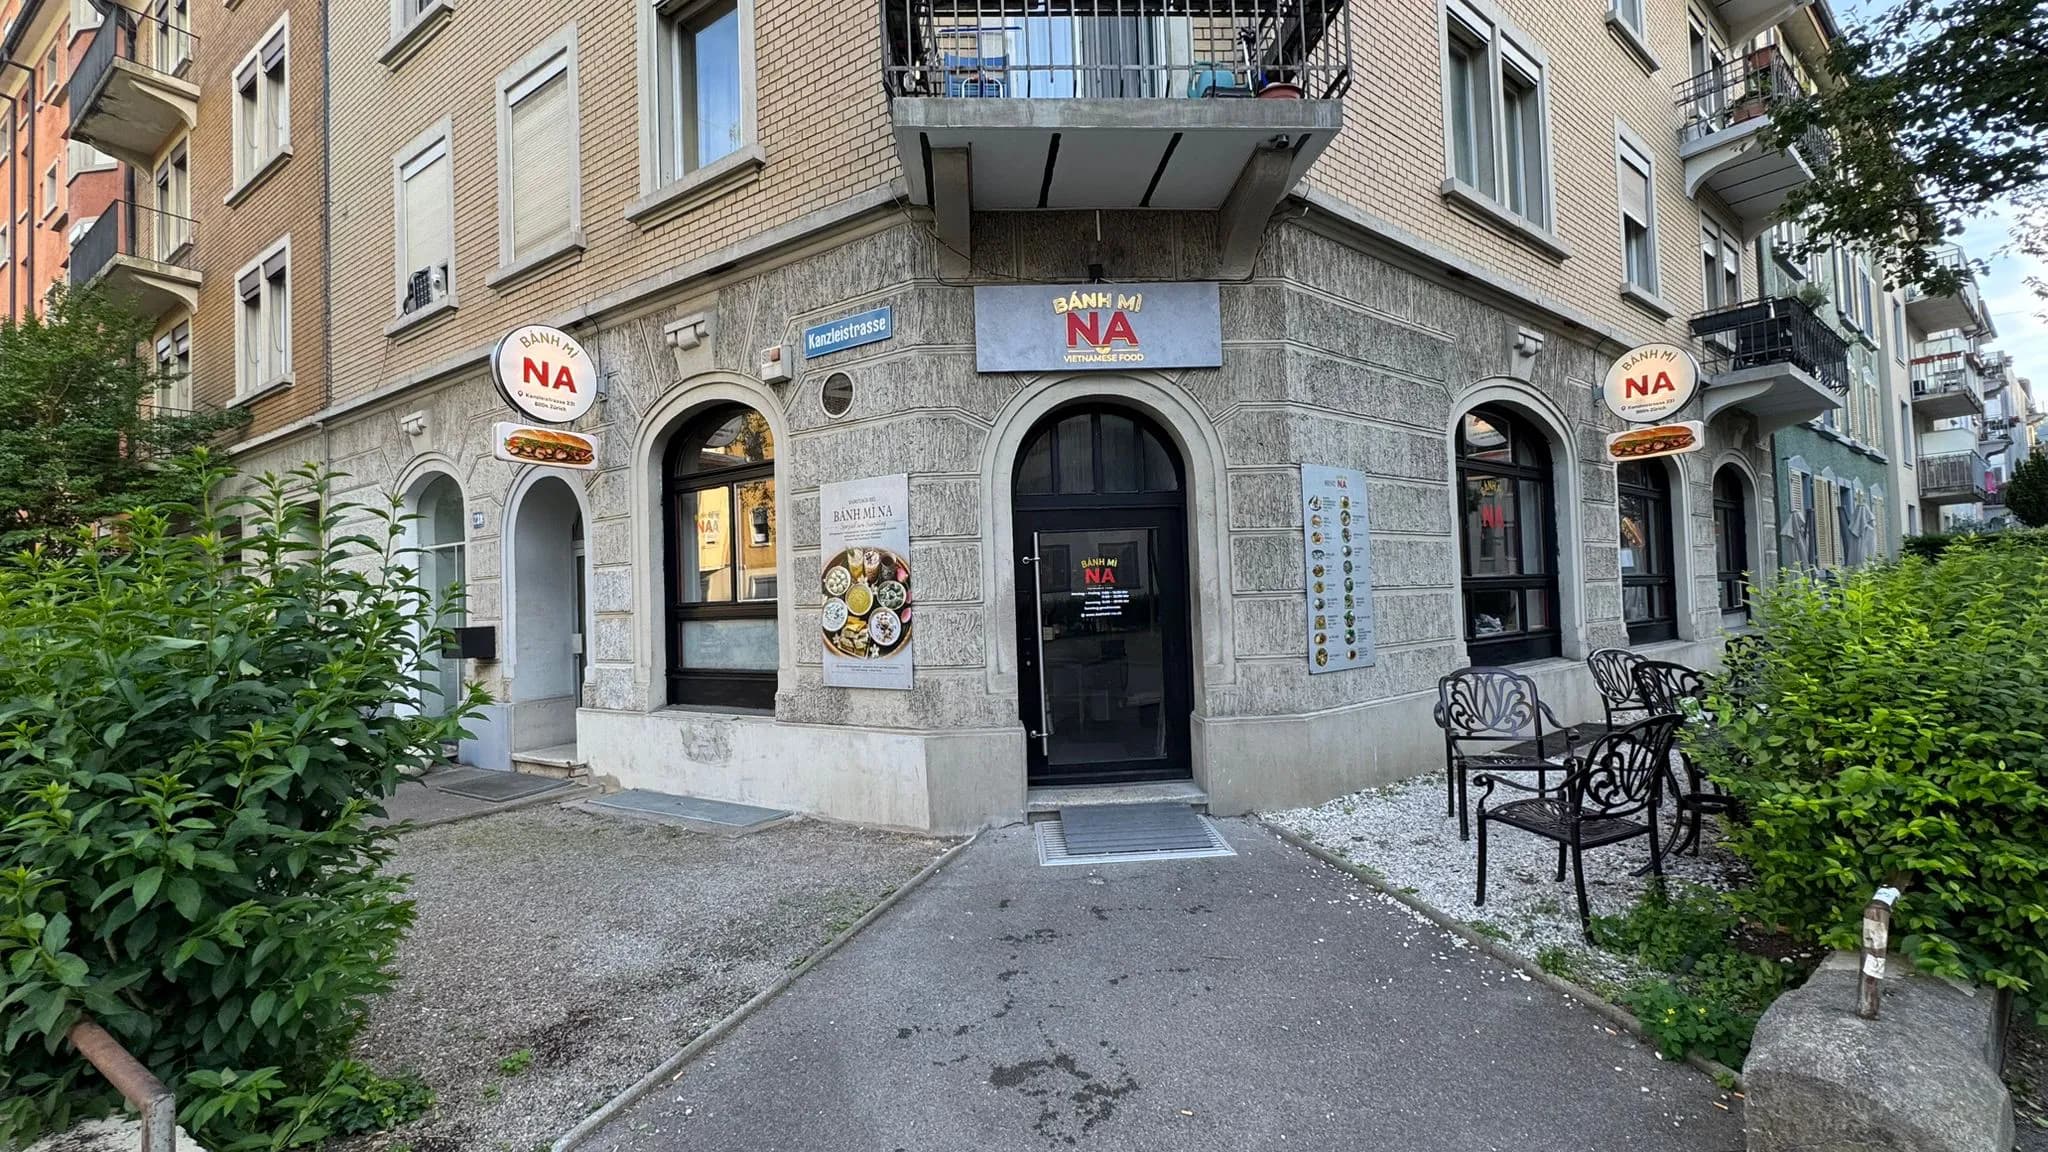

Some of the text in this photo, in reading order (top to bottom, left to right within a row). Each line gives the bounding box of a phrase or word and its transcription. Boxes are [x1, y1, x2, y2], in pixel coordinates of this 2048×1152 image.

[1053, 291, 1143, 314] BÁNH MÌ
[519, 330, 560, 349] BÁNH
[808, 317, 886, 350] Kanzleistrasse
[1065, 311, 1140, 347] NA
[1064, 353, 1144, 363] VIETNAMESE FOOD
[1621, 349, 1658, 371] BÁNH
[523, 357, 577, 394] NA
[1625, 371, 1676, 399] NA
[878, 505, 893, 518] NA
[1084, 567, 1116, 584] NA
